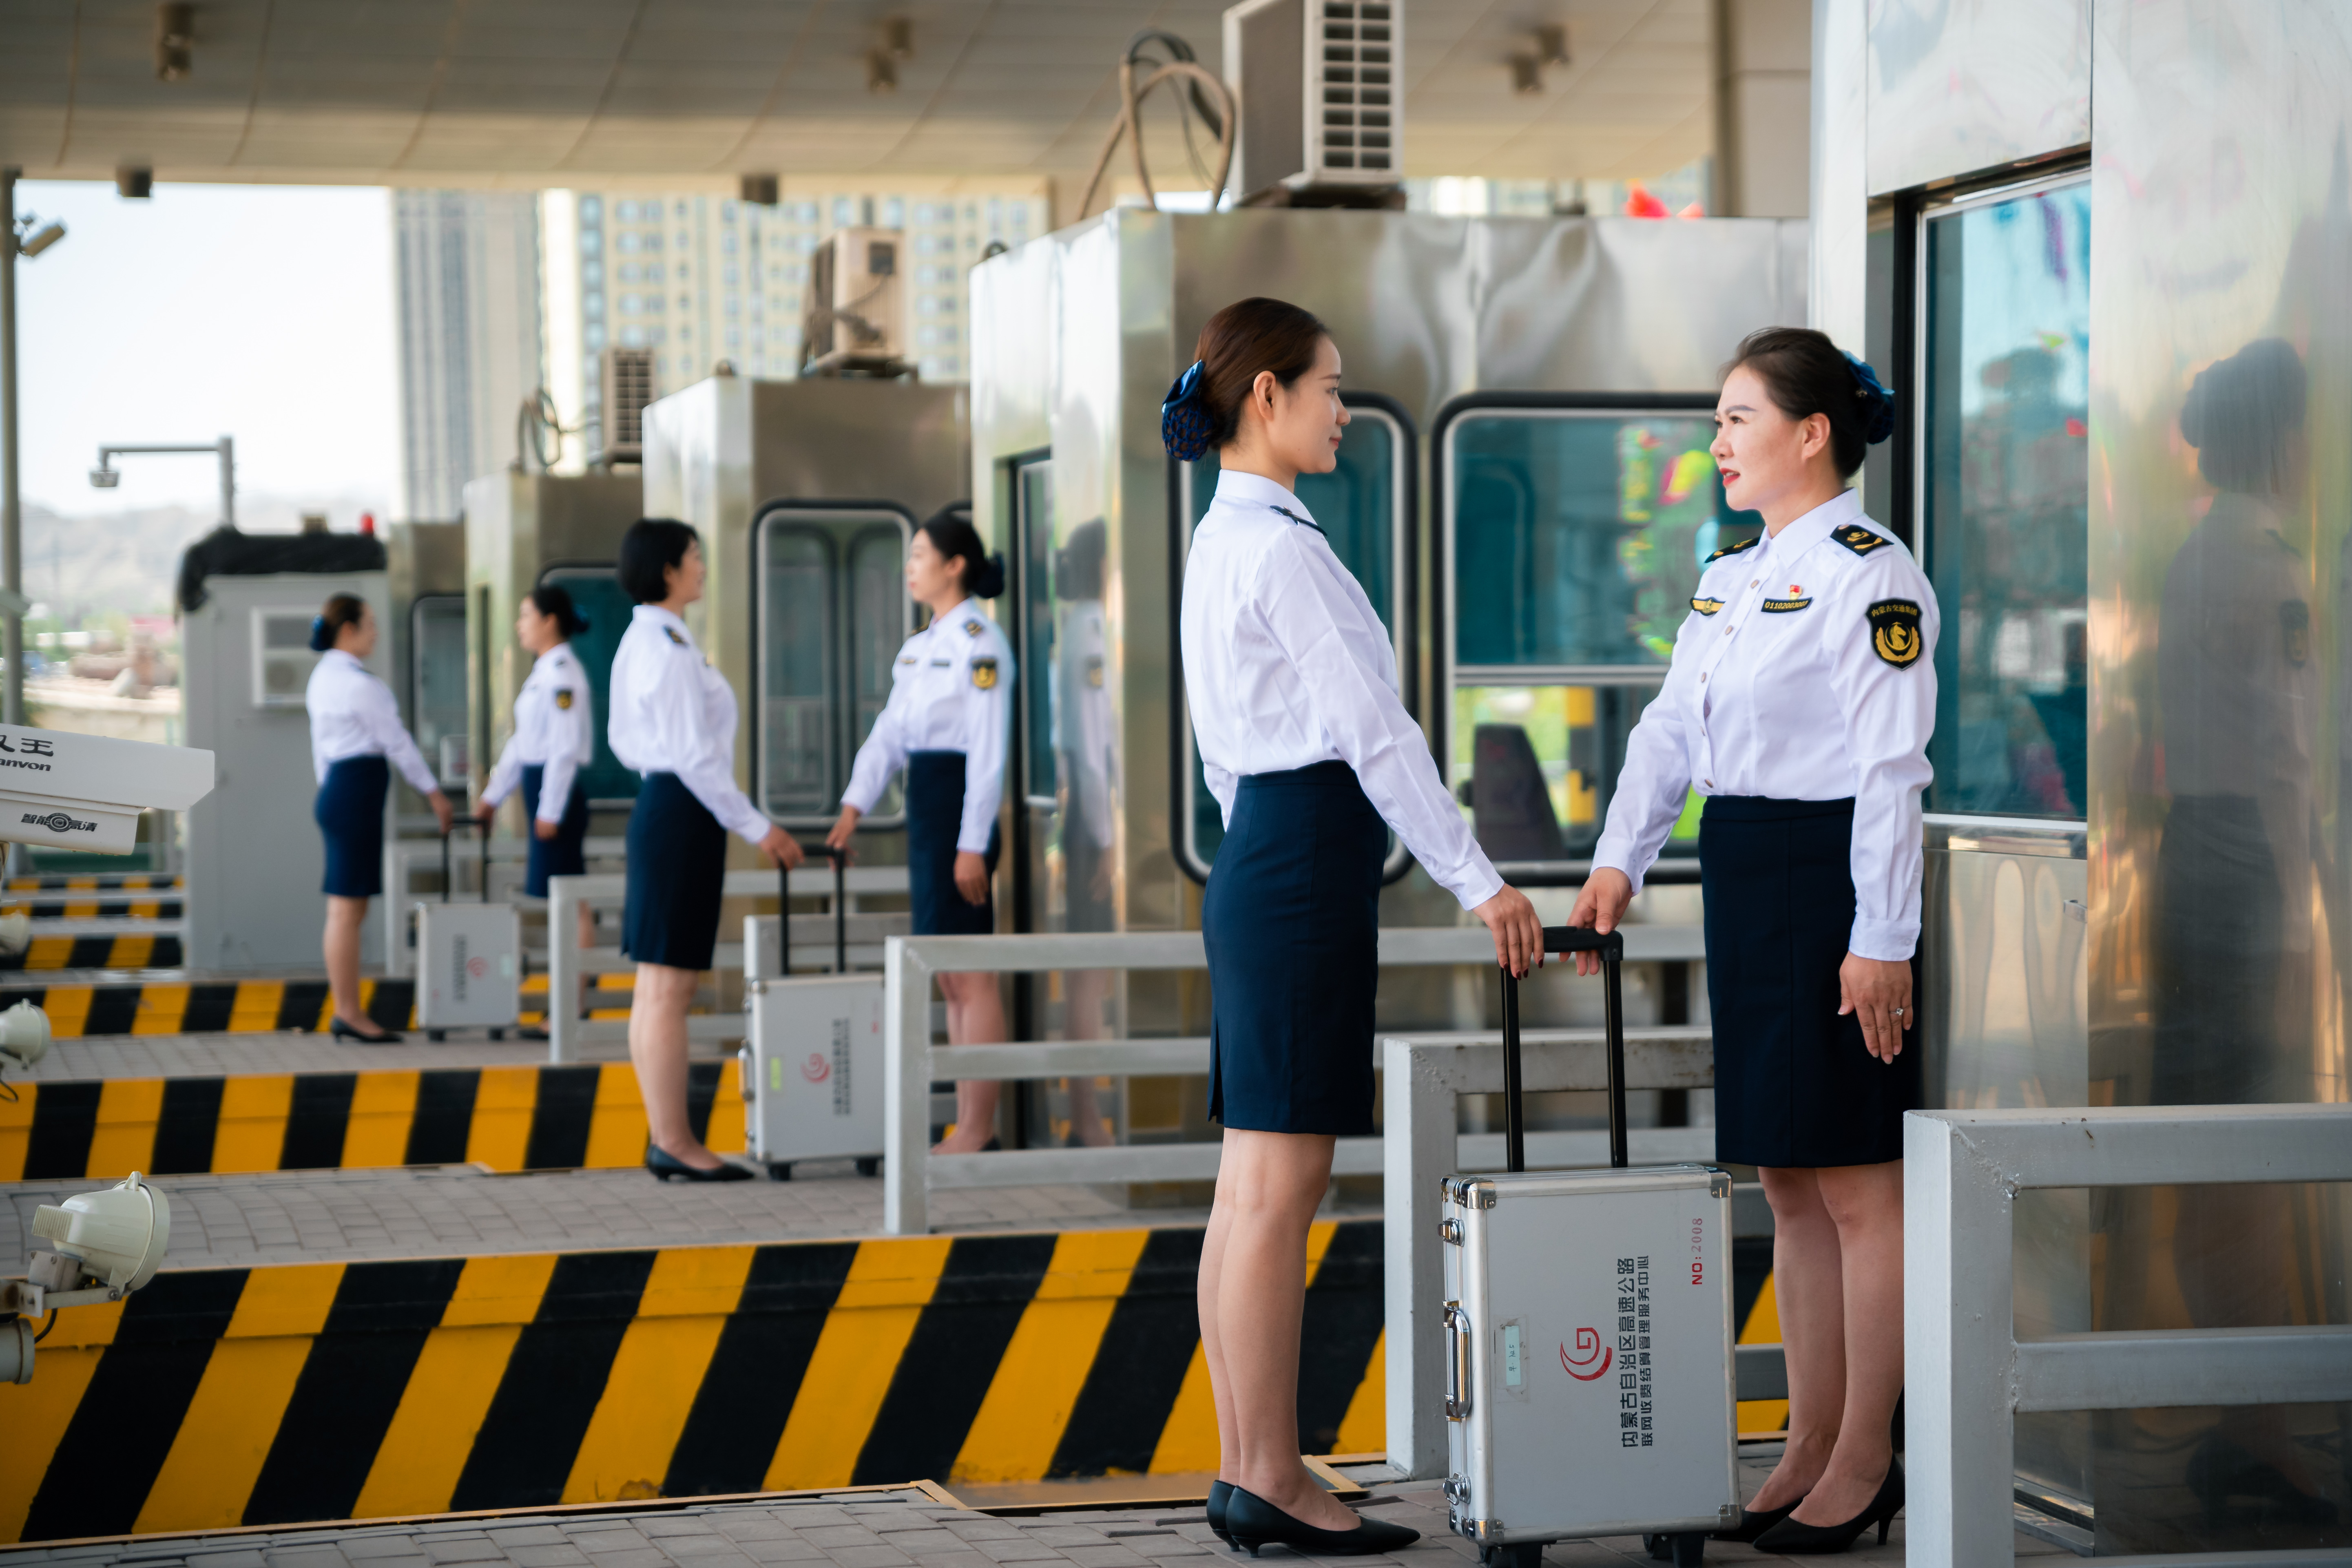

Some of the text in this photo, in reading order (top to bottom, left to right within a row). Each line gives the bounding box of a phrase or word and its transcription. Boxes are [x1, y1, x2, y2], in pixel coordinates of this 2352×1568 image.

[1617, 1258, 1638, 1448] 内蒙古自治区高速公路
[1637, 1255, 1653, 1447] 联网收费结算管理服务中心
